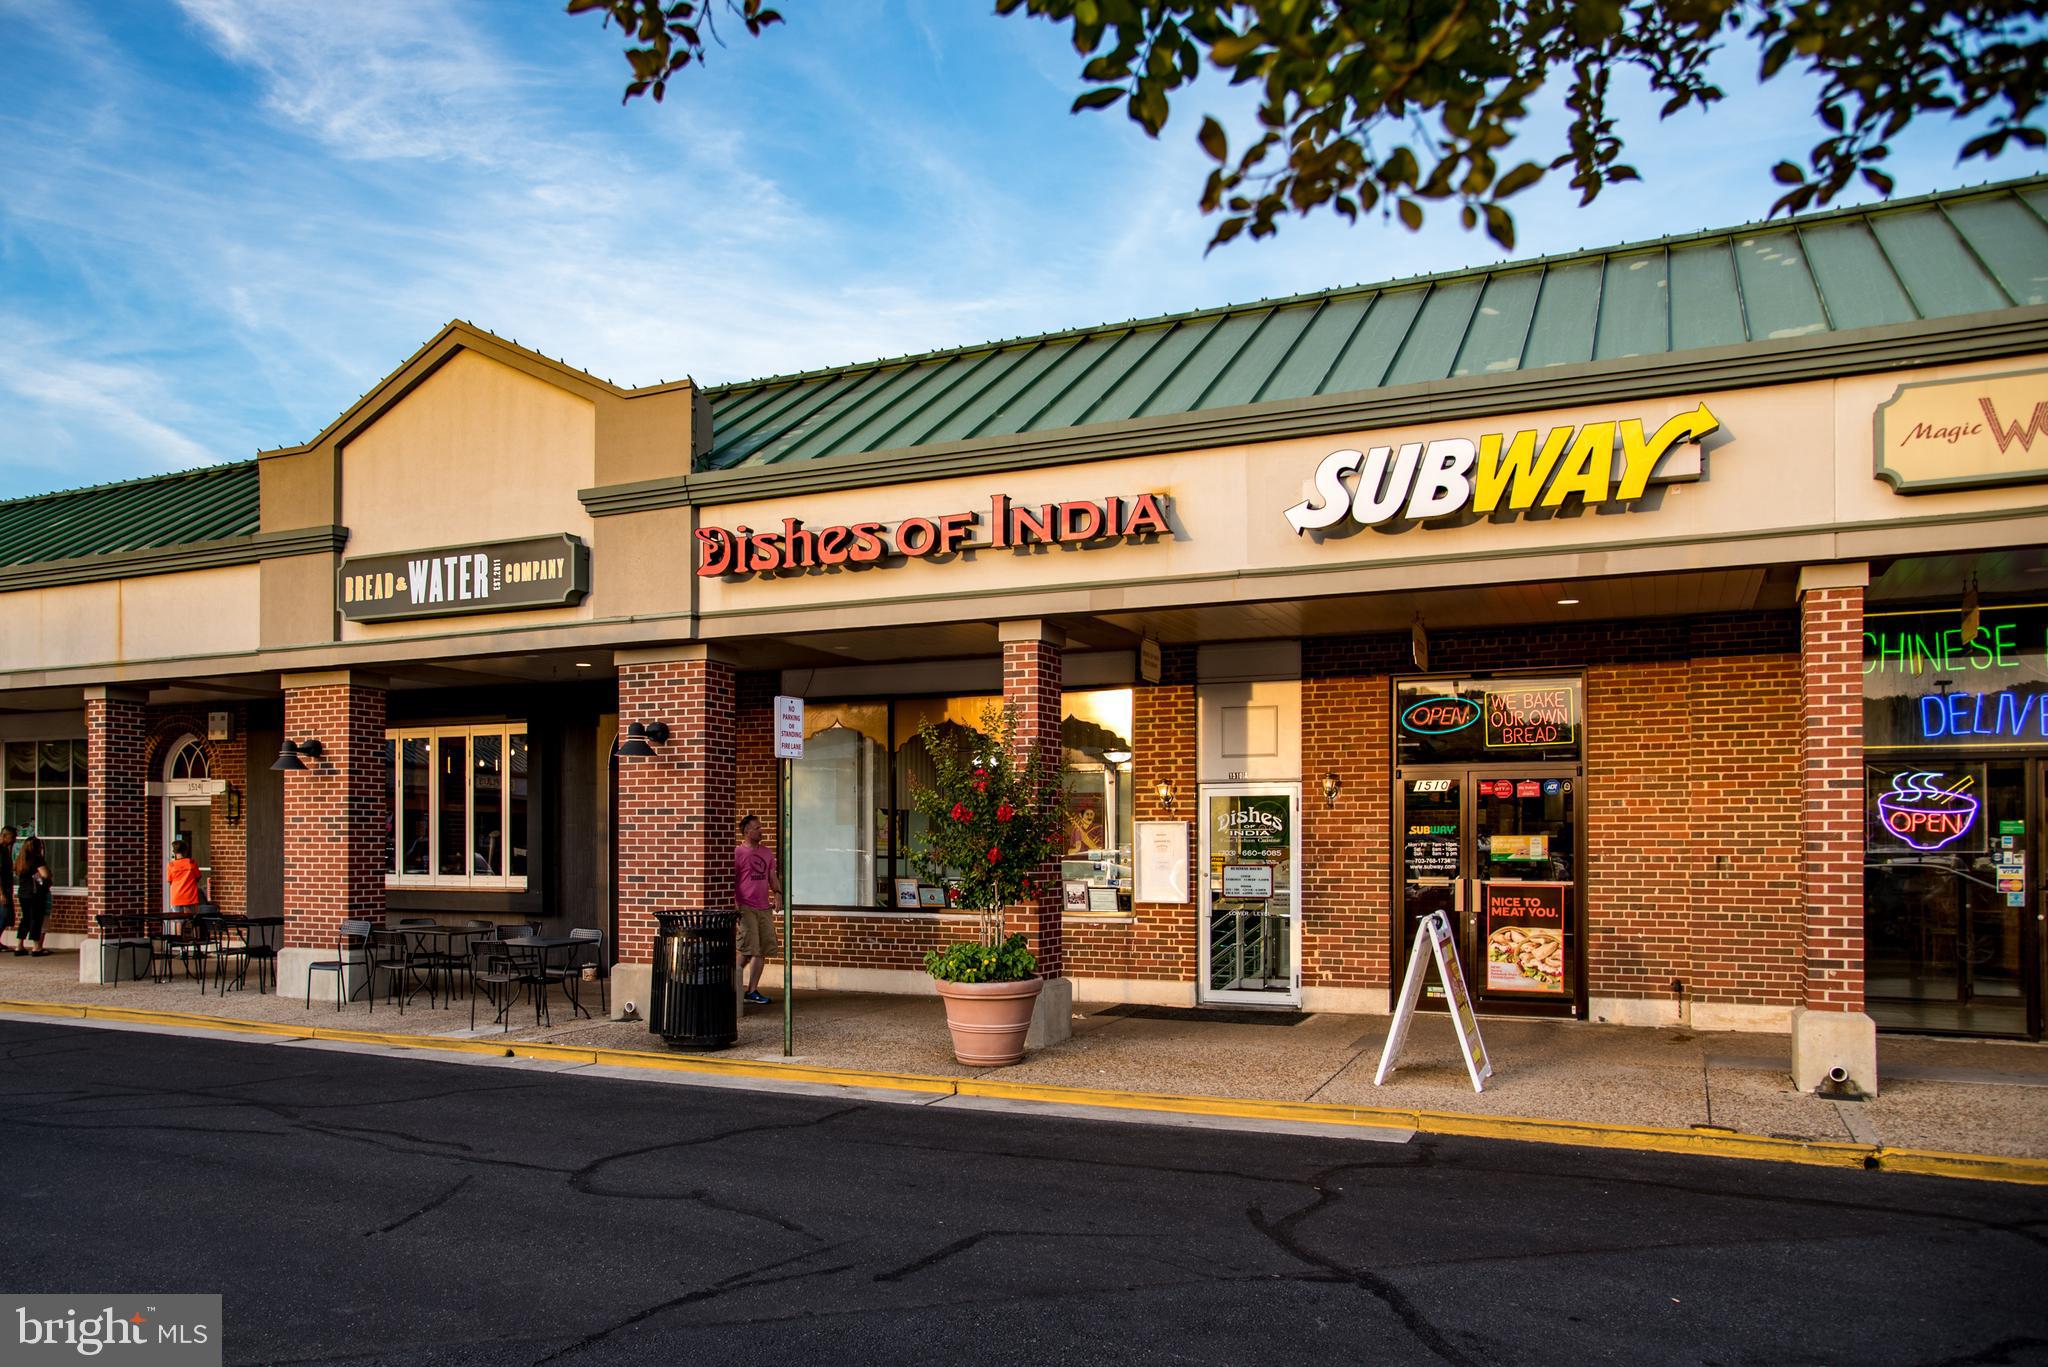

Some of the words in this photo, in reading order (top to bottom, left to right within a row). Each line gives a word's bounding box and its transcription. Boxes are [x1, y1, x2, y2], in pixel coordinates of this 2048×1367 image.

[1900, 422, 1983, 447] Magic
[1283, 401, 1720, 537] SUBWAY
[695, 517, 887, 577] Dishes
[896, 511, 979, 557] OF
[990, 493, 1174, 549] INDIA
[344, 572, 394, 603] BREAD
[395, 576, 408, 591] &
[408, 553, 489, 604] WATER
[504, 558, 565, 584] COMPANY
[1863, 624, 2020, 675] CHINESE
[788, 705, 796, 713] NO
[1490, 693, 1517, 710] WE
[1523, 691, 1566, 709] BAKE
[782, 713, 801, 722] PARKING
[1412, 706, 1469, 726] OPEN
[1490, 711, 1525, 728] OUR
[1529, 708, 1568, 725] OWN
[781, 730, 802, 739] STANDING
[1502, 726, 1557, 744] BREAD
[781, 742, 790, 750] FIRE
[791, 743, 802, 751] LANE
[188, 783, 201, 791] 1514
[1416, 780, 1449, 792] 1510
[1217, 806, 1283, 832] Dishes
[1890, 811, 1962, 834] OPEN
[1408, 825, 1457, 835] SUBWAY
[1242, 849, 1282, 857] 660-6085
[1491, 897, 1521, 907] NICE
[1523, 897, 1541, 907] TO
[1491, 907, 1527, 917] MEAT
[1528, 907, 1559, 918] YOU.
